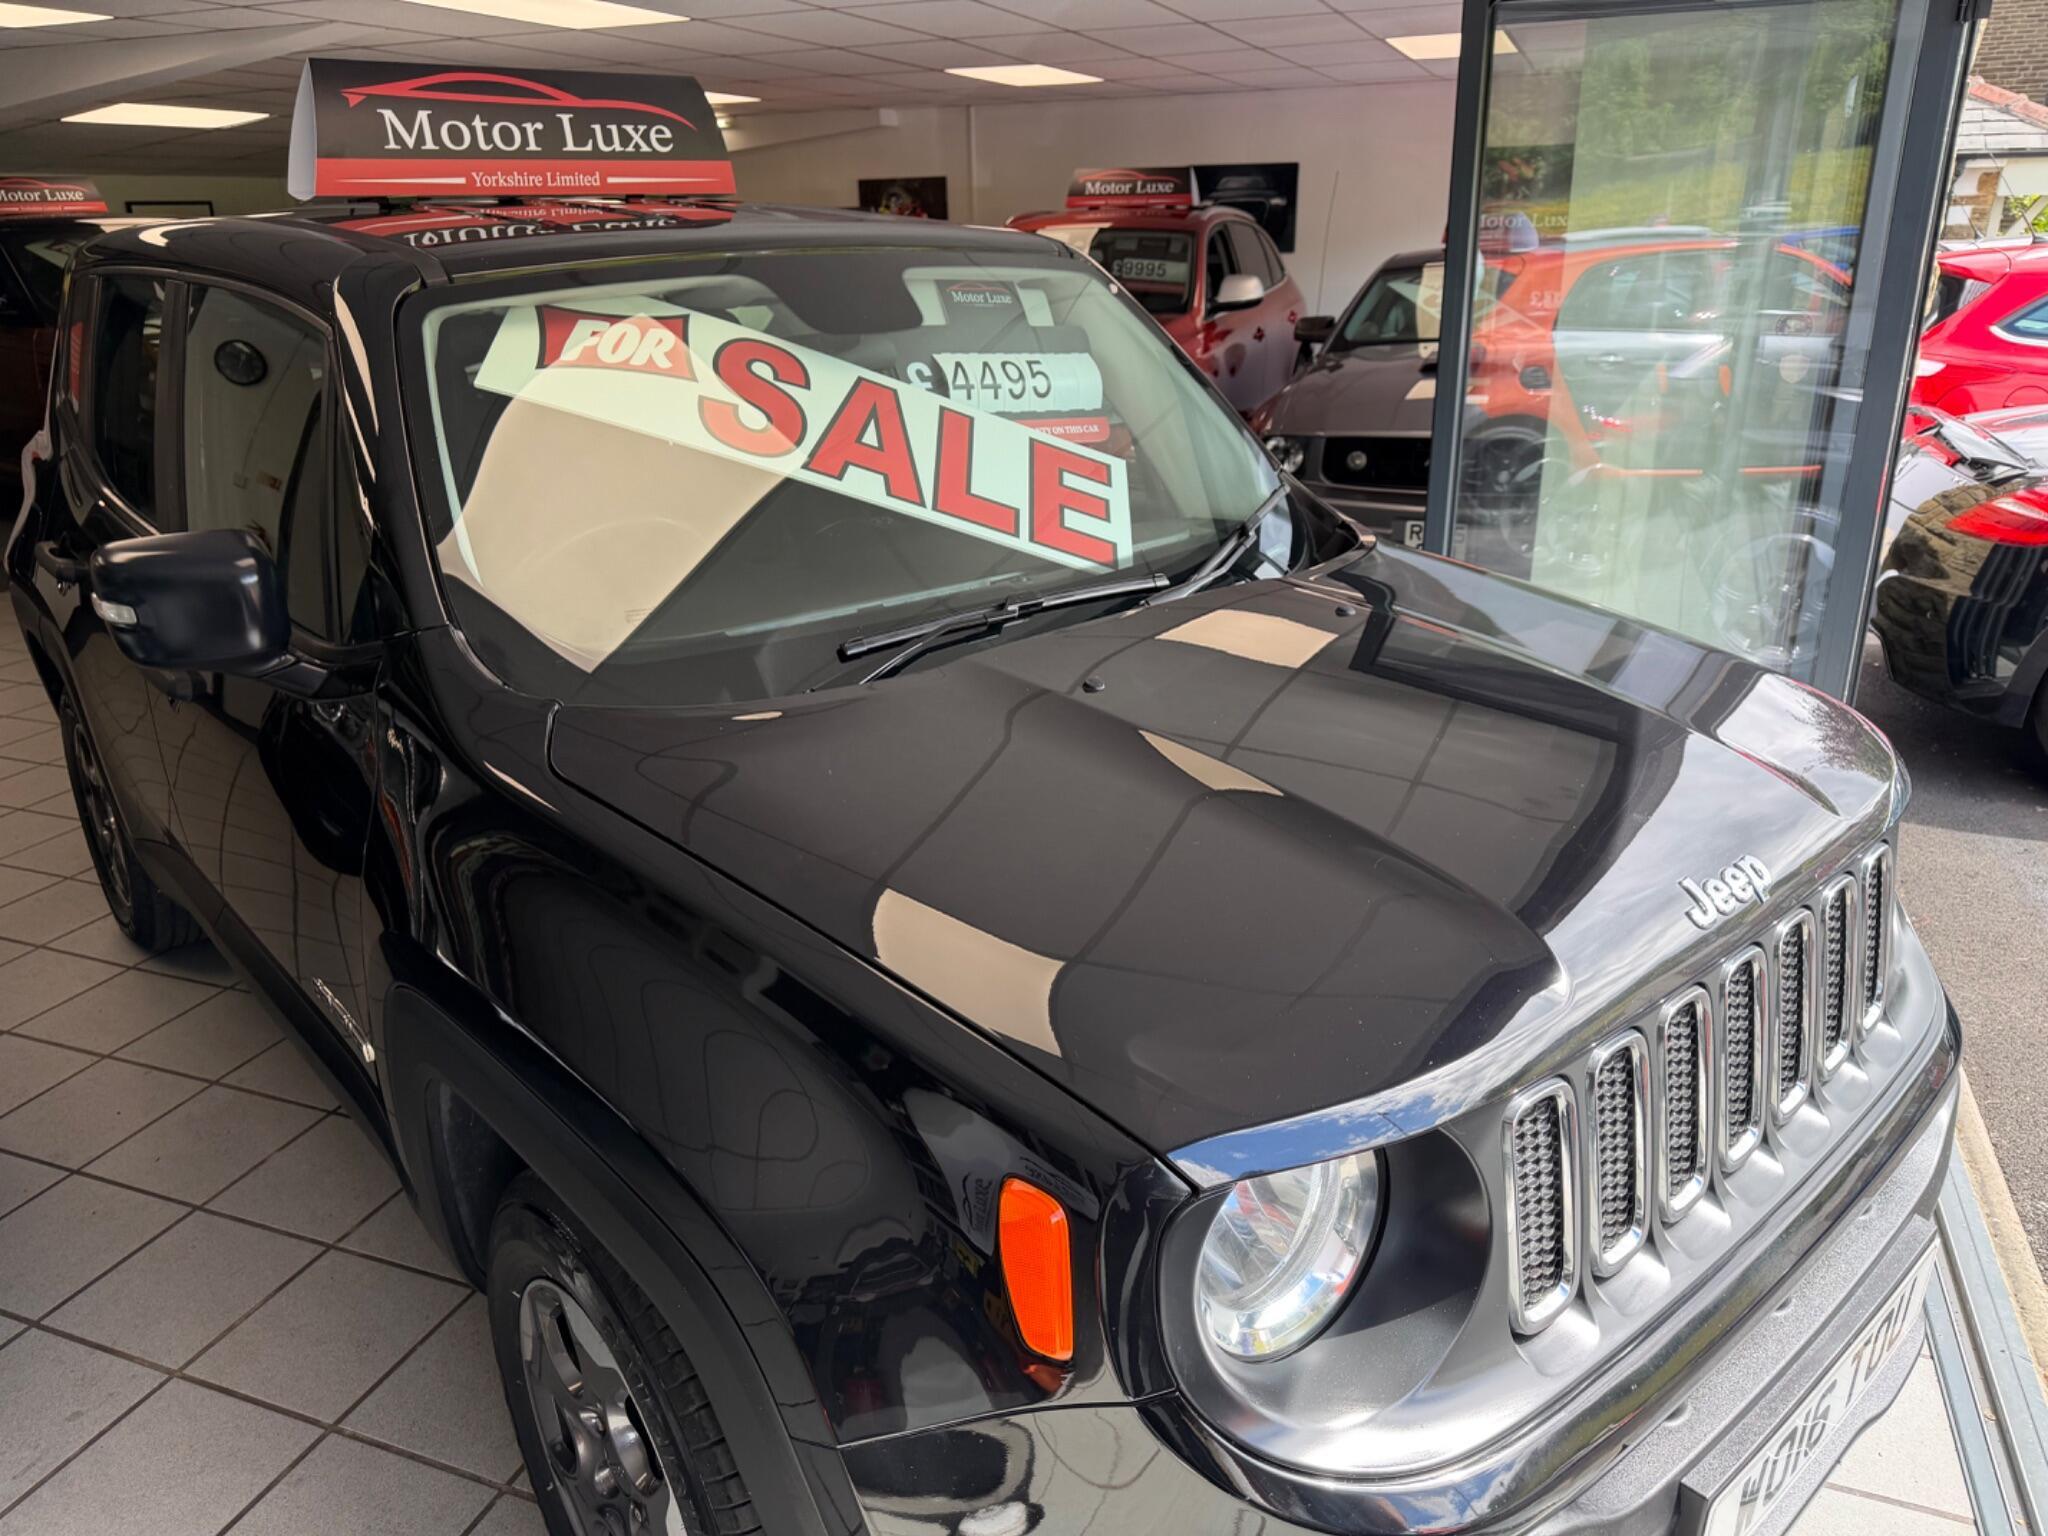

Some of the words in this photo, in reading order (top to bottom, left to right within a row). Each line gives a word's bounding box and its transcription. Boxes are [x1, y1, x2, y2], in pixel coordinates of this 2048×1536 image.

[377, 108, 543, 152] Motor
[555, 112, 674, 153] Luxe
[471, 170, 543, 188] Yorkshire
[546, 170, 601, 187] Limited
[1084, 180, 1132, 195] Motor
[1136, 180, 1175, 194] Luxe
[44, 189, 84, 201] Luxe
[560, 319, 674, 370] FOR
[697, 337, 1118, 570] SALE
[1678, 855, 1771, 930] Jeep
